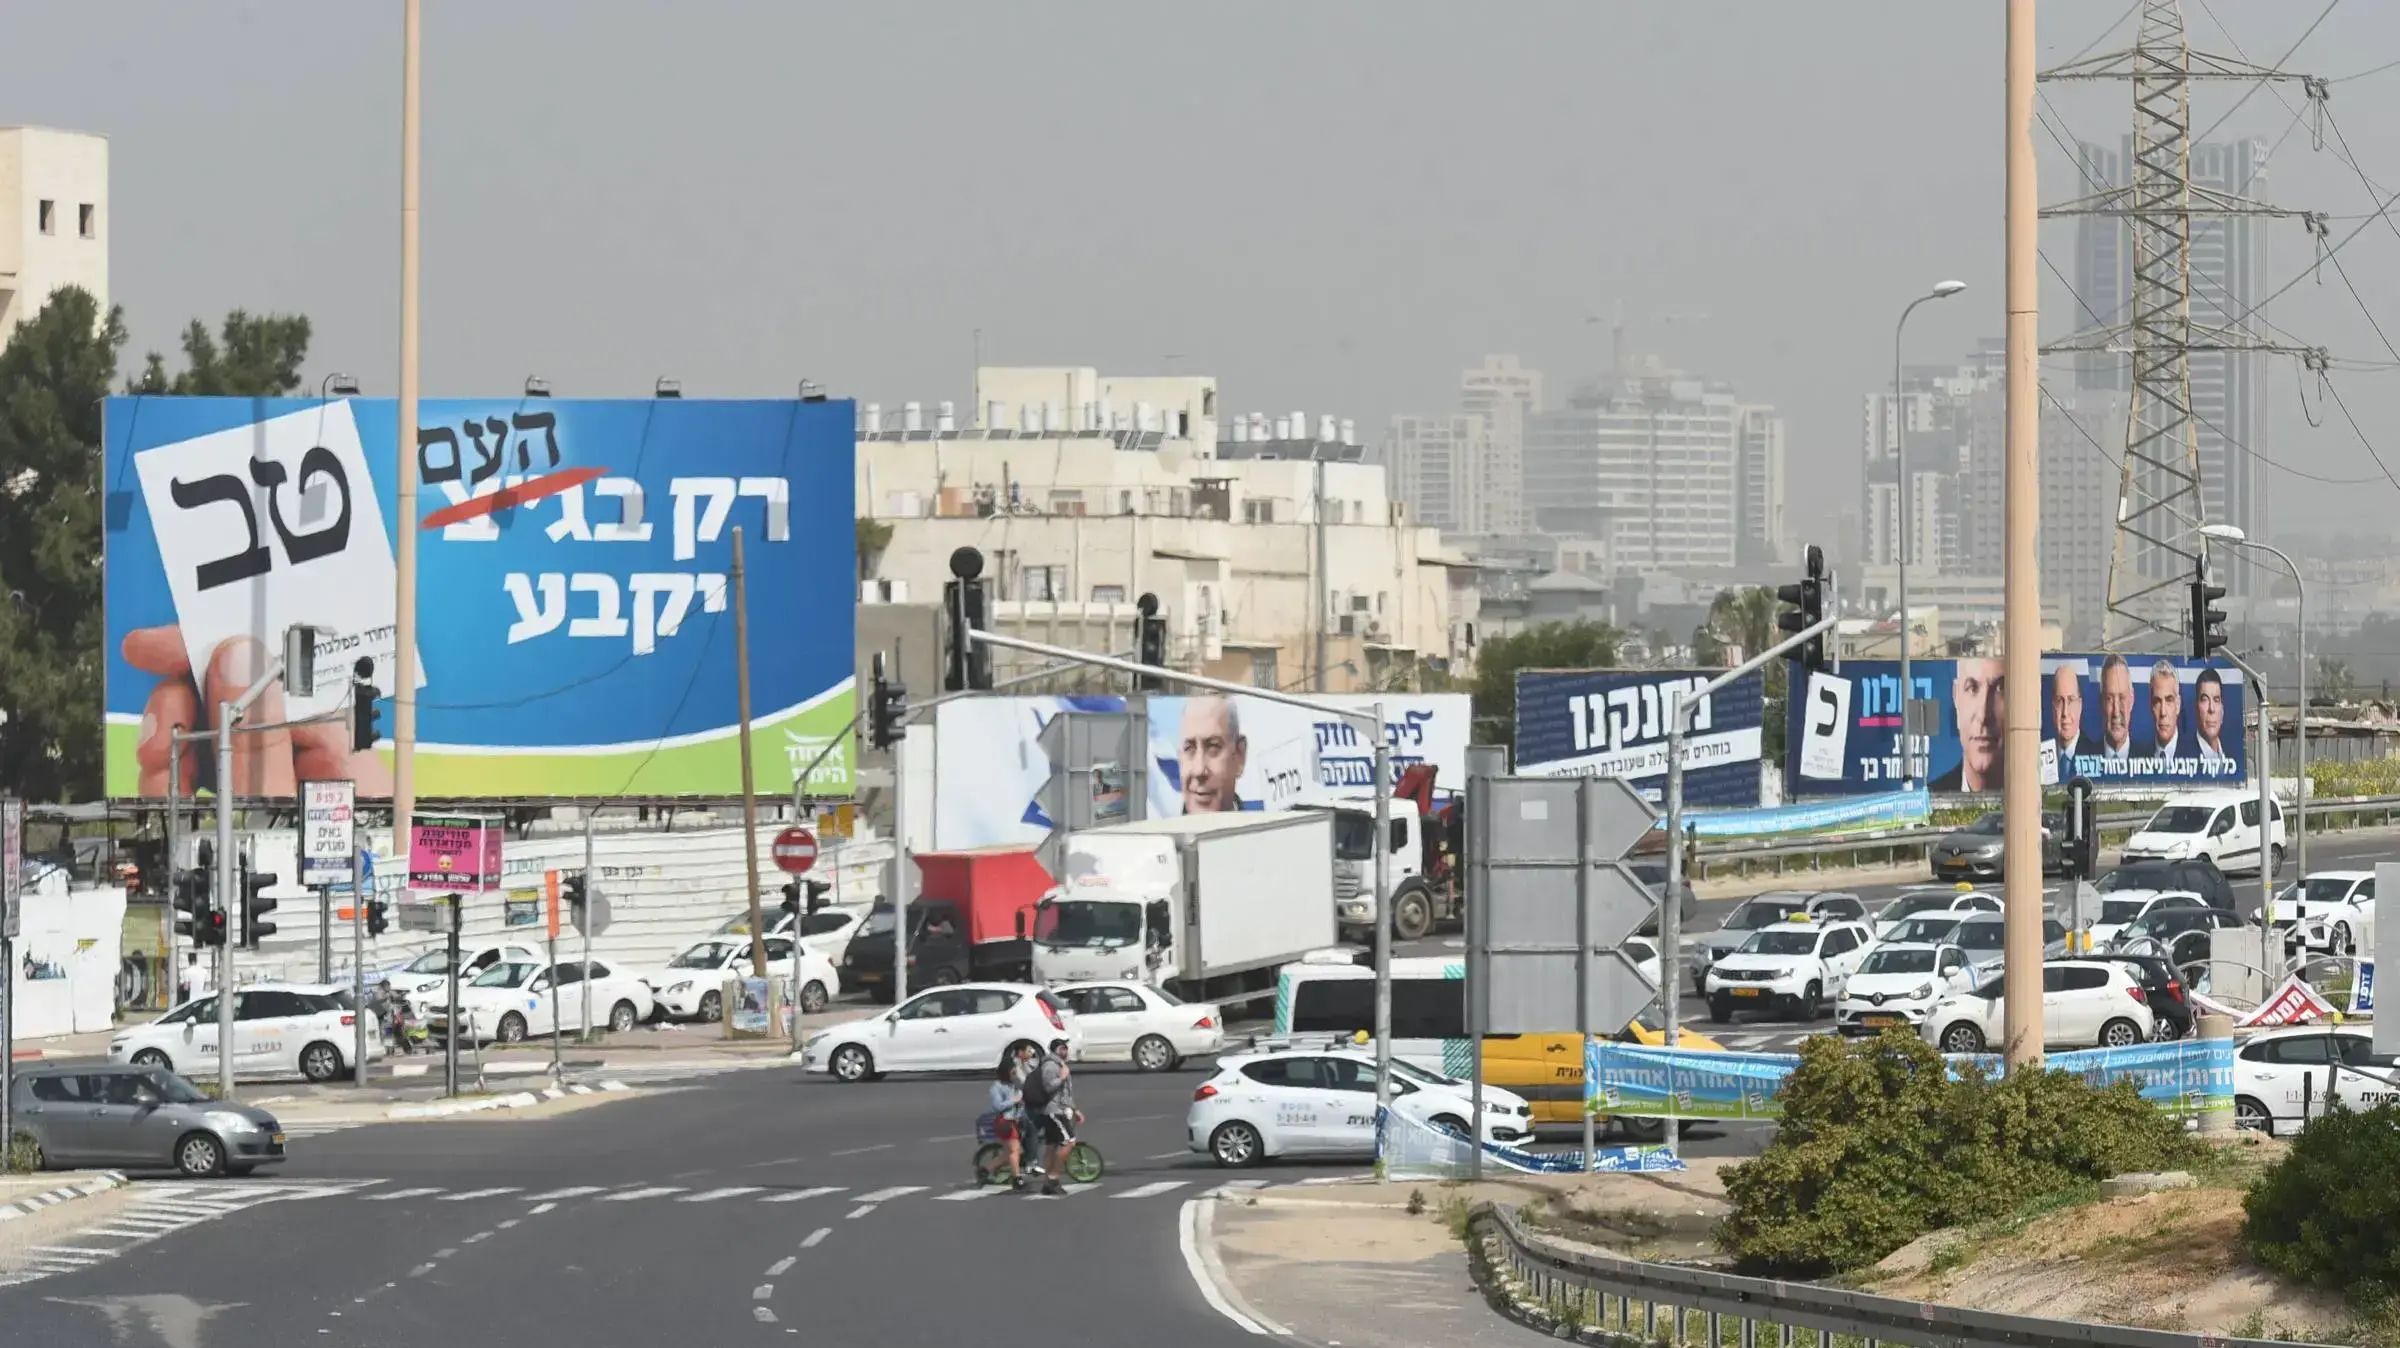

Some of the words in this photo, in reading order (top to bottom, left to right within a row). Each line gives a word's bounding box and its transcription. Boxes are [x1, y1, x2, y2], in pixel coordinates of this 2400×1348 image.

[417, 411, 561, 485] העם
[170, 446, 353, 593] טב
[668, 476, 791, 561] רק
[502, 572, 728, 655] יקבע
[364, 622, 397, 644] יחוד
[1569, 676, 1712, 751] נחנקנו
[1815, 685, 1839, 737] כ
[1313, 722, 1358, 752] חזק
[1648, 749, 1690, 767] משלה
[1694, 741, 1732, 760] בוחרים
[1600, 755, 1646, 776] שעובדת
[2101, 754, 2129, 775] כחול
[2129, 756, 2165, 777] ניצחון
[2200, 754, 2220, 778] קול
[2220, 752, 2237, 774] כל
[1605, 1068, 1666, 1088] אחדות
[1675, 1070, 1737, 1088] אחדות
